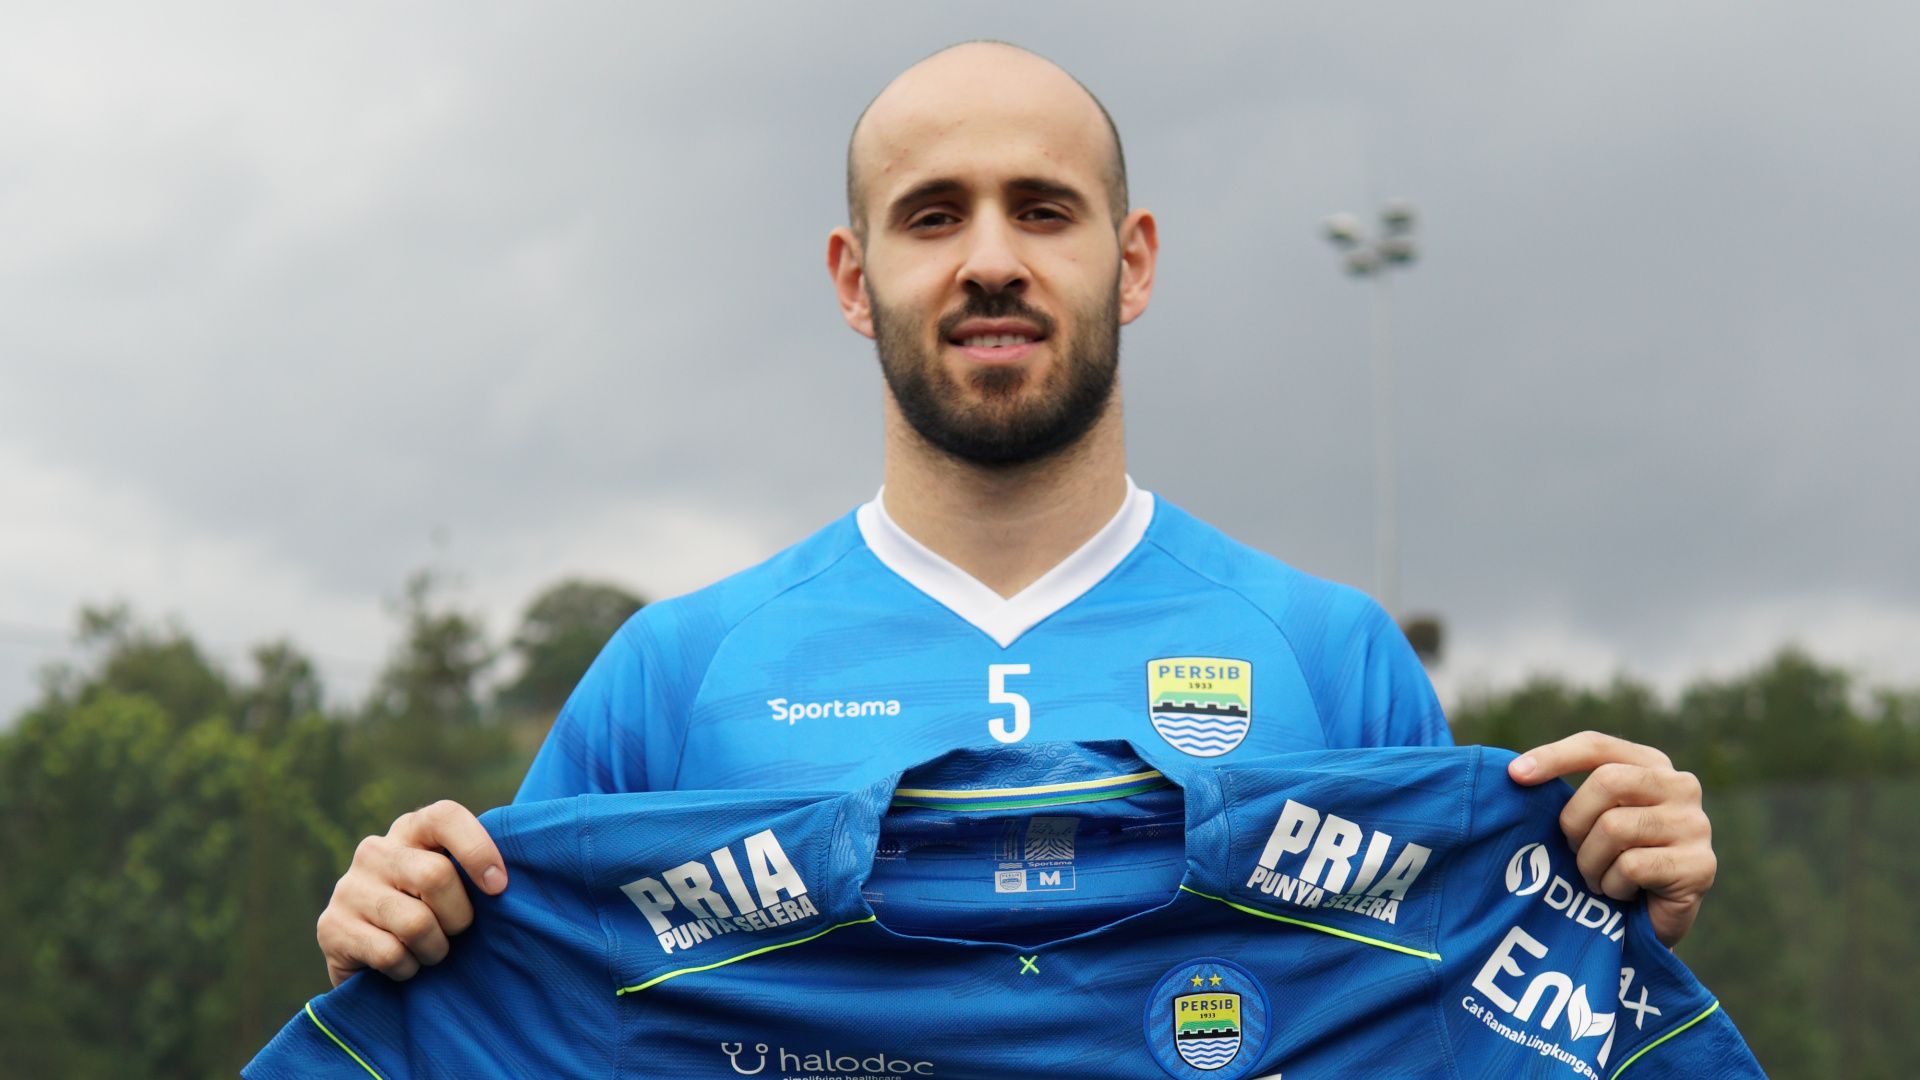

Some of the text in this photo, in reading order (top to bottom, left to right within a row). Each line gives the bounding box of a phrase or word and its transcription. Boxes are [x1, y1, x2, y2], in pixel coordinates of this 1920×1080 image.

[1158, 665, 1240, 680] PERSIB
[1188, 682, 1213, 690] 1933
[767, 698, 901, 726] Sportama
[988, 663, 1031, 744] 5
[1258, 798, 1433, 901] PRIA
[1027, 860, 1073, 868] Sportama
[1039, 870, 1061, 886] M
[618, 828, 808, 936] PRIA
[1246, 865, 1399, 925] PUNYA SELERA
[657, 894, 820, 955] PUNYA SELERA
[1181, 999, 1233, 1011] PERSIB
[1461, 995, 1599, 1080] Cat Ramah Lingkungan
[779, 1047, 935, 1075] halodoc
